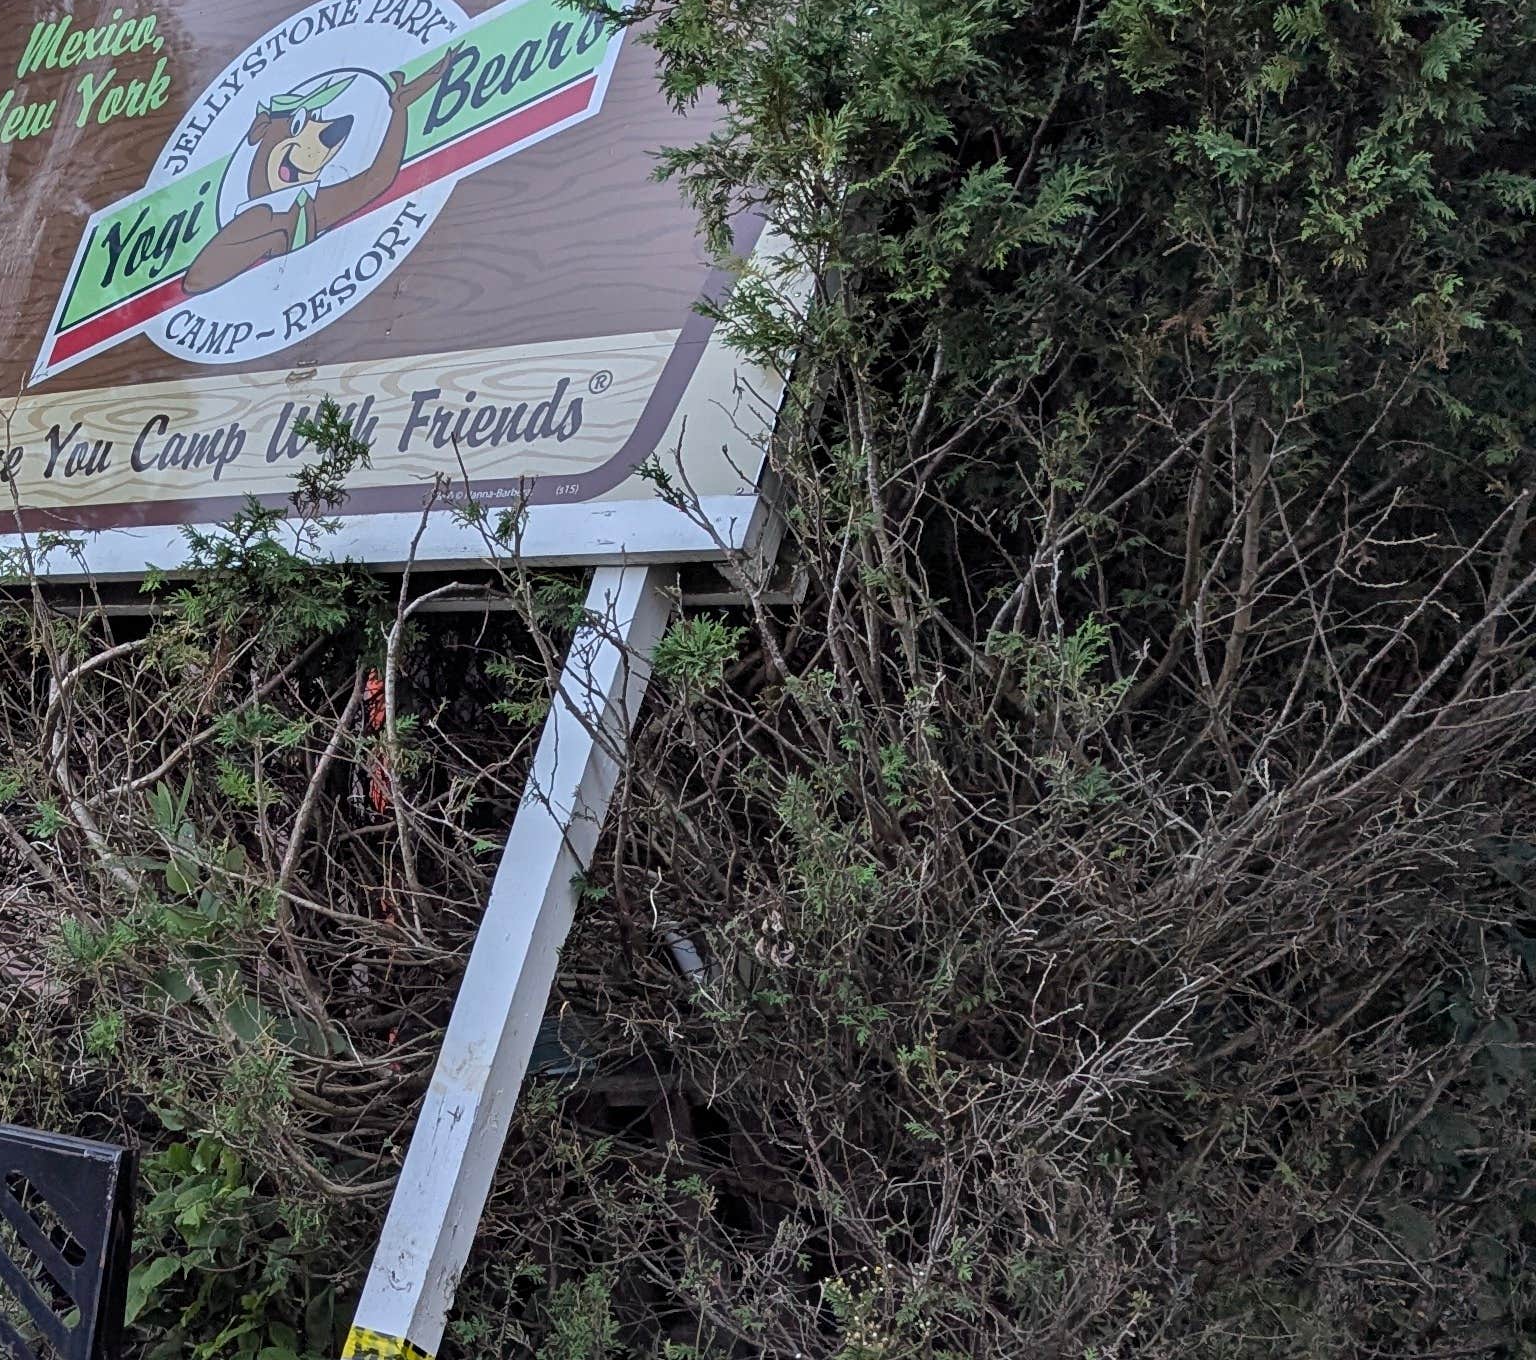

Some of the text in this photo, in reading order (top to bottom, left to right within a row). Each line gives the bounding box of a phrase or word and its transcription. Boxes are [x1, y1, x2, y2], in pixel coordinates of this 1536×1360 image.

[16, 7, 166, 79] Mexico,
[75, 56, 172, 129] York
[100, 180, 212, 288] Yogi
[43, 422, 114, 480] You
[130, 414, 248, 482] Camp
[265, 394, 380, 463] Wh
